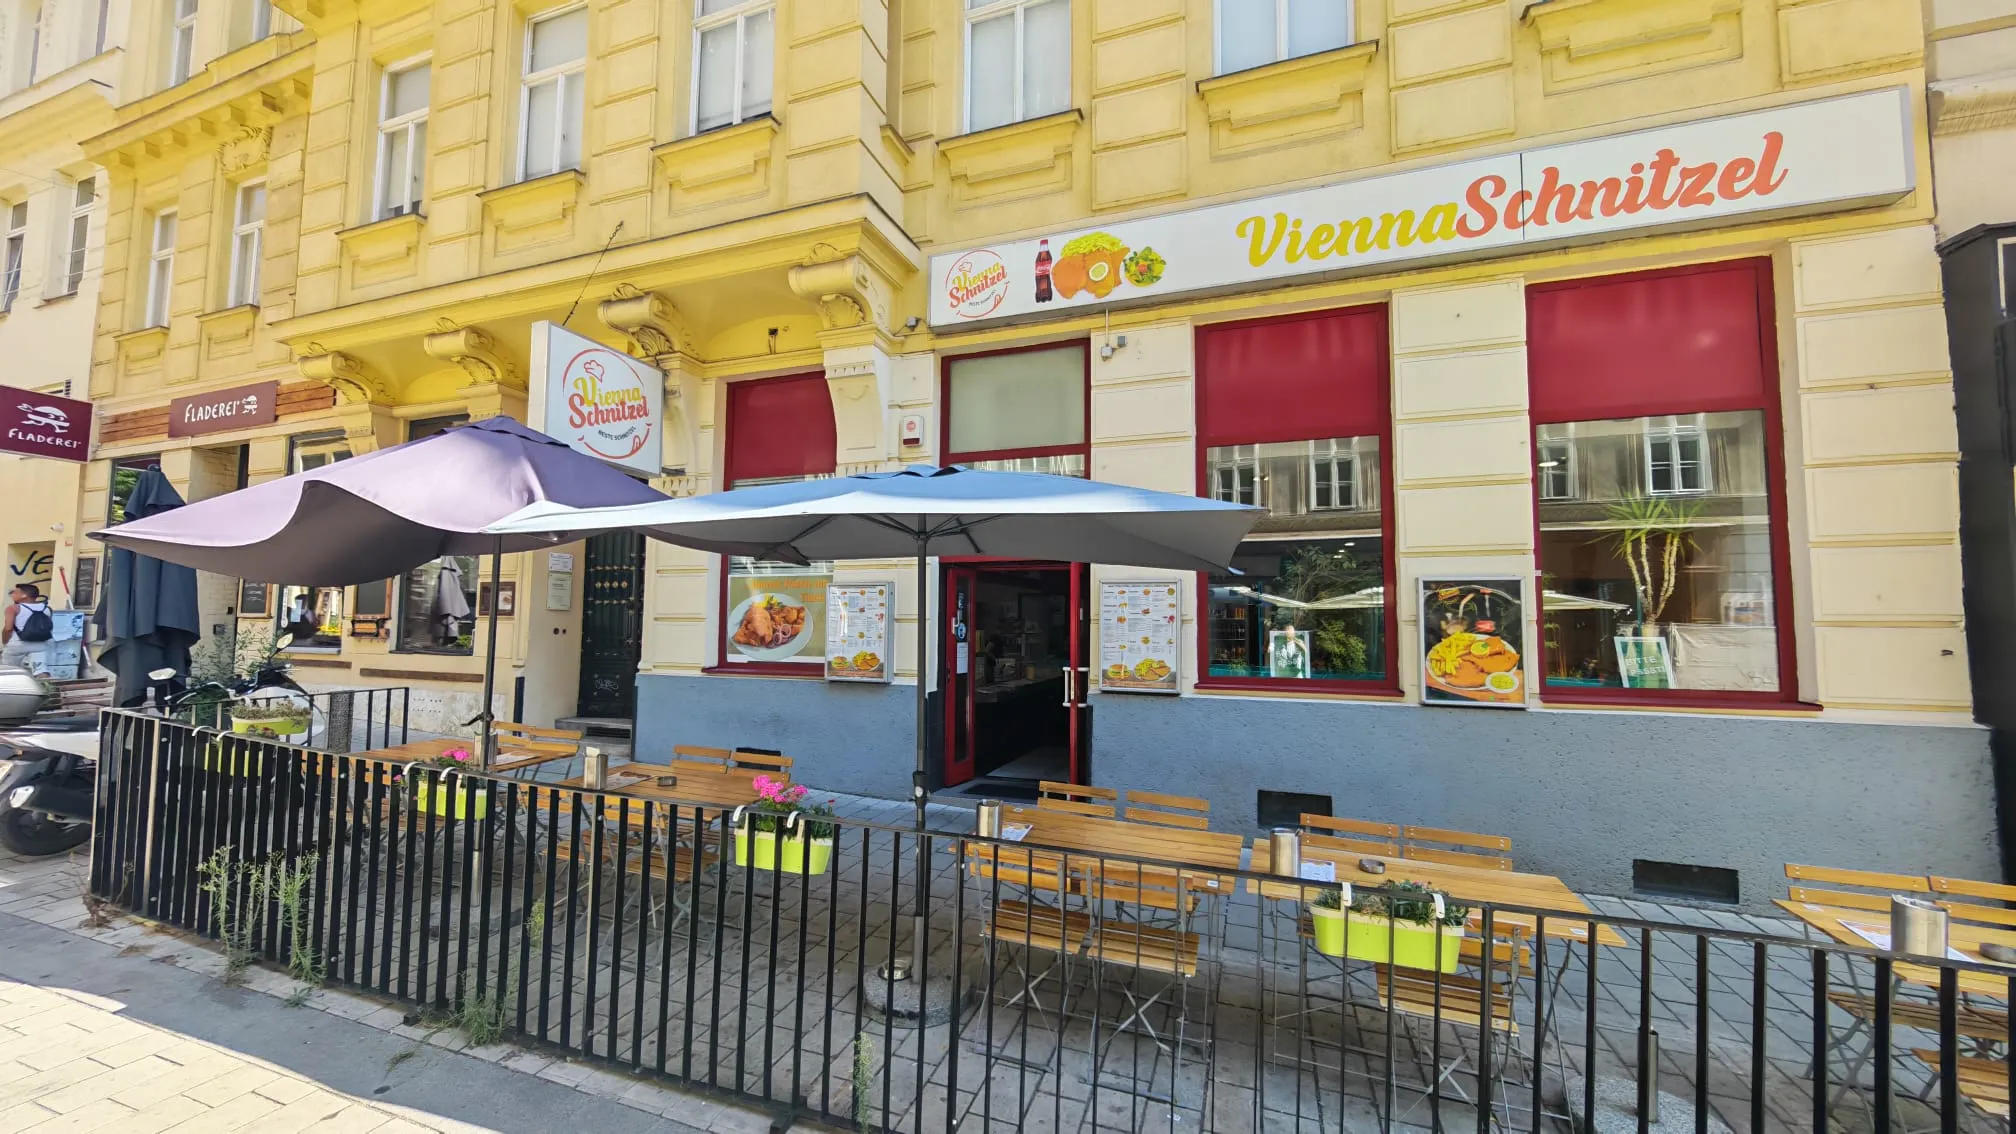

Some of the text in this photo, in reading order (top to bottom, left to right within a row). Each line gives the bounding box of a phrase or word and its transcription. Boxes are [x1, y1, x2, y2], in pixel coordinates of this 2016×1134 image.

[949, 265, 1007, 308] Schnitzel
[952, 262, 1001, 292] Vienna
[573, 376, 641, 406] Vienna
[568, 393, 650, 428] Schnitzel
